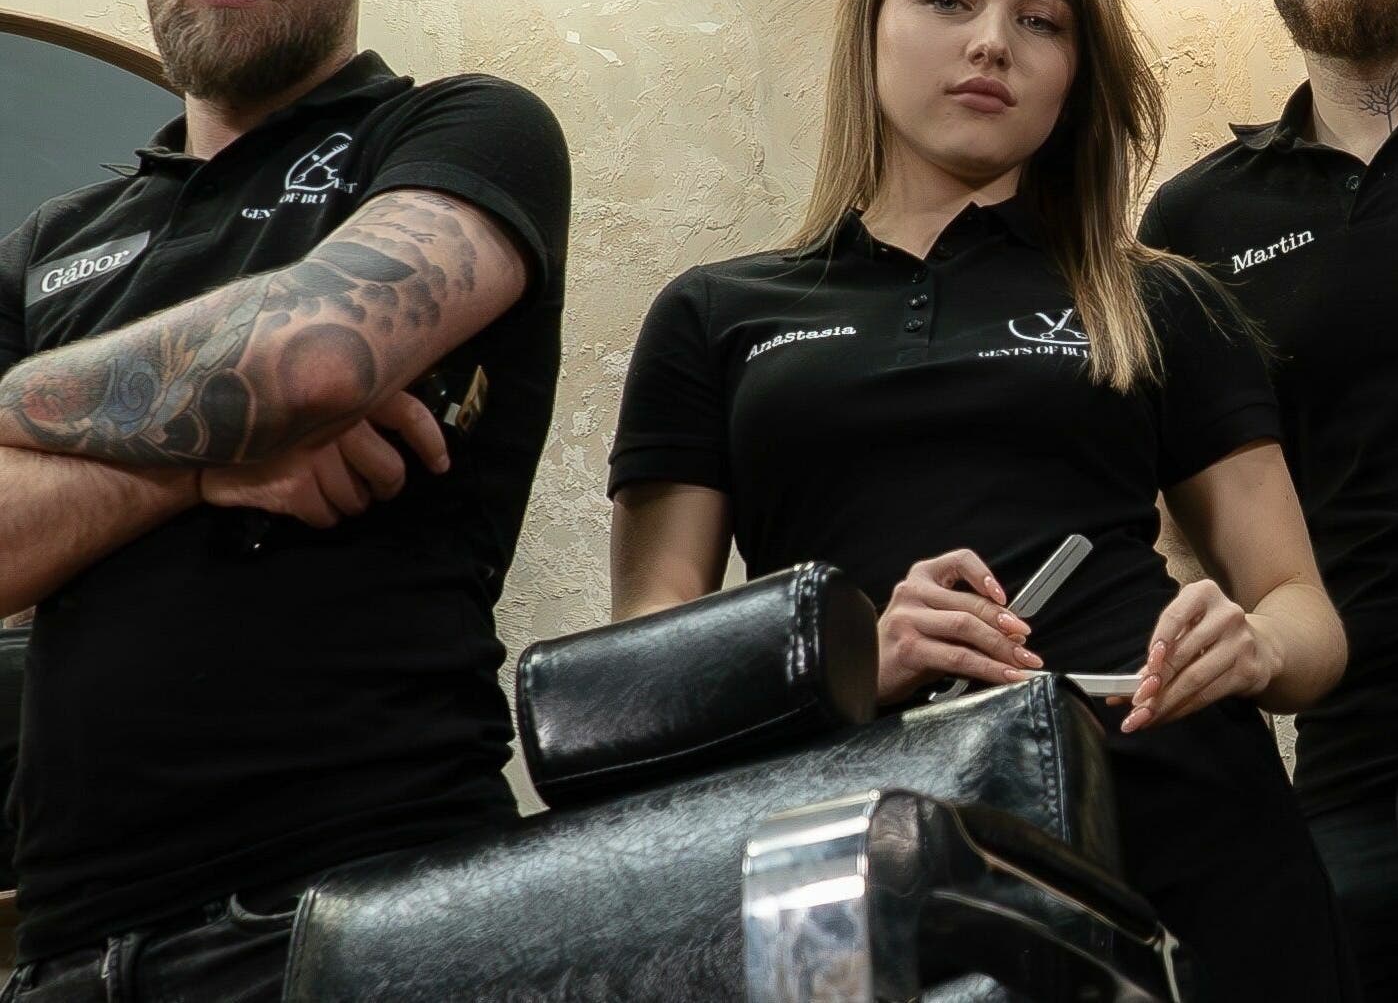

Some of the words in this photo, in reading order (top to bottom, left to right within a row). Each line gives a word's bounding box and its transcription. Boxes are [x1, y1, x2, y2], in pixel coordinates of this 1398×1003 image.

[41, 249, 131, 293] Gábor
[1231, 229, 1316, 275] Martin
[1035, 344, 1059, 356] OF
